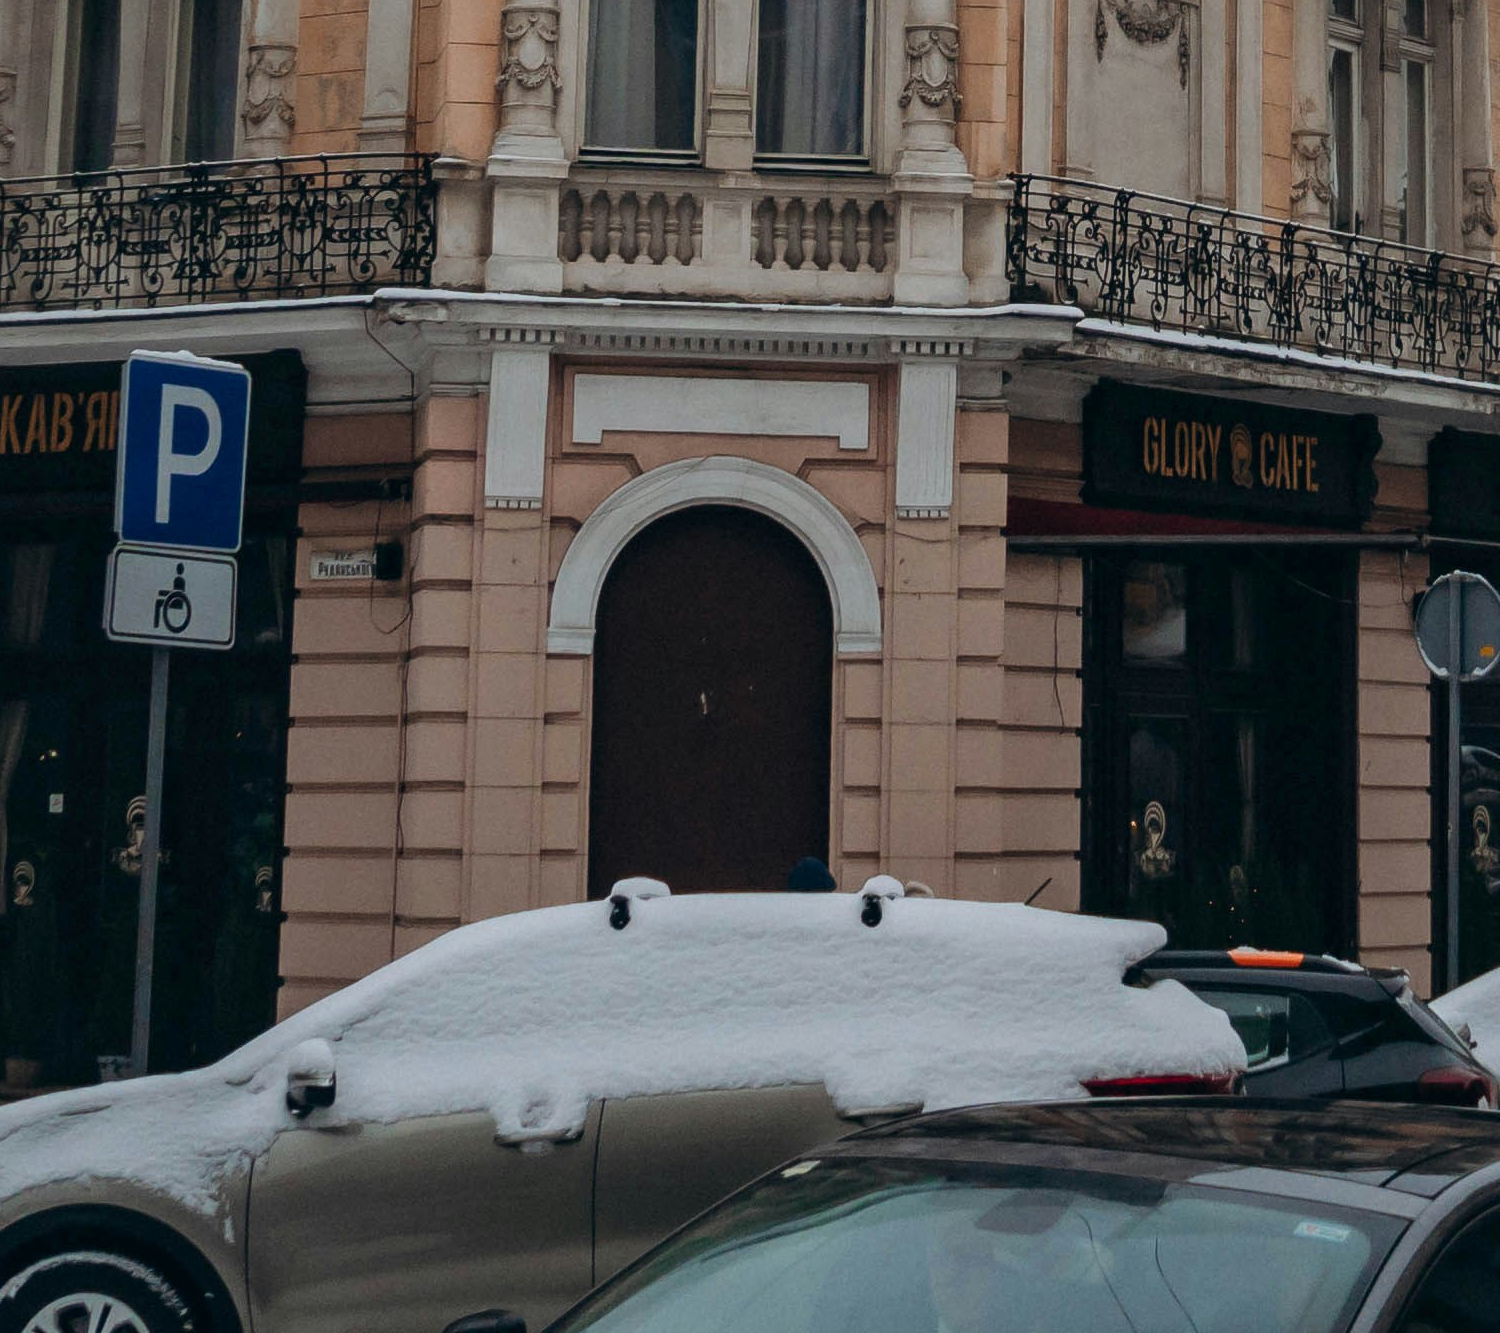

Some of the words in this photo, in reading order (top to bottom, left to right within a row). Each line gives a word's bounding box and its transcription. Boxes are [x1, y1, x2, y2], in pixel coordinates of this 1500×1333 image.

[155, 383, 222, 524] P
[1142, 415, 1222, 483] GLORY
[1259, 431, 1319, 492] CAFE
